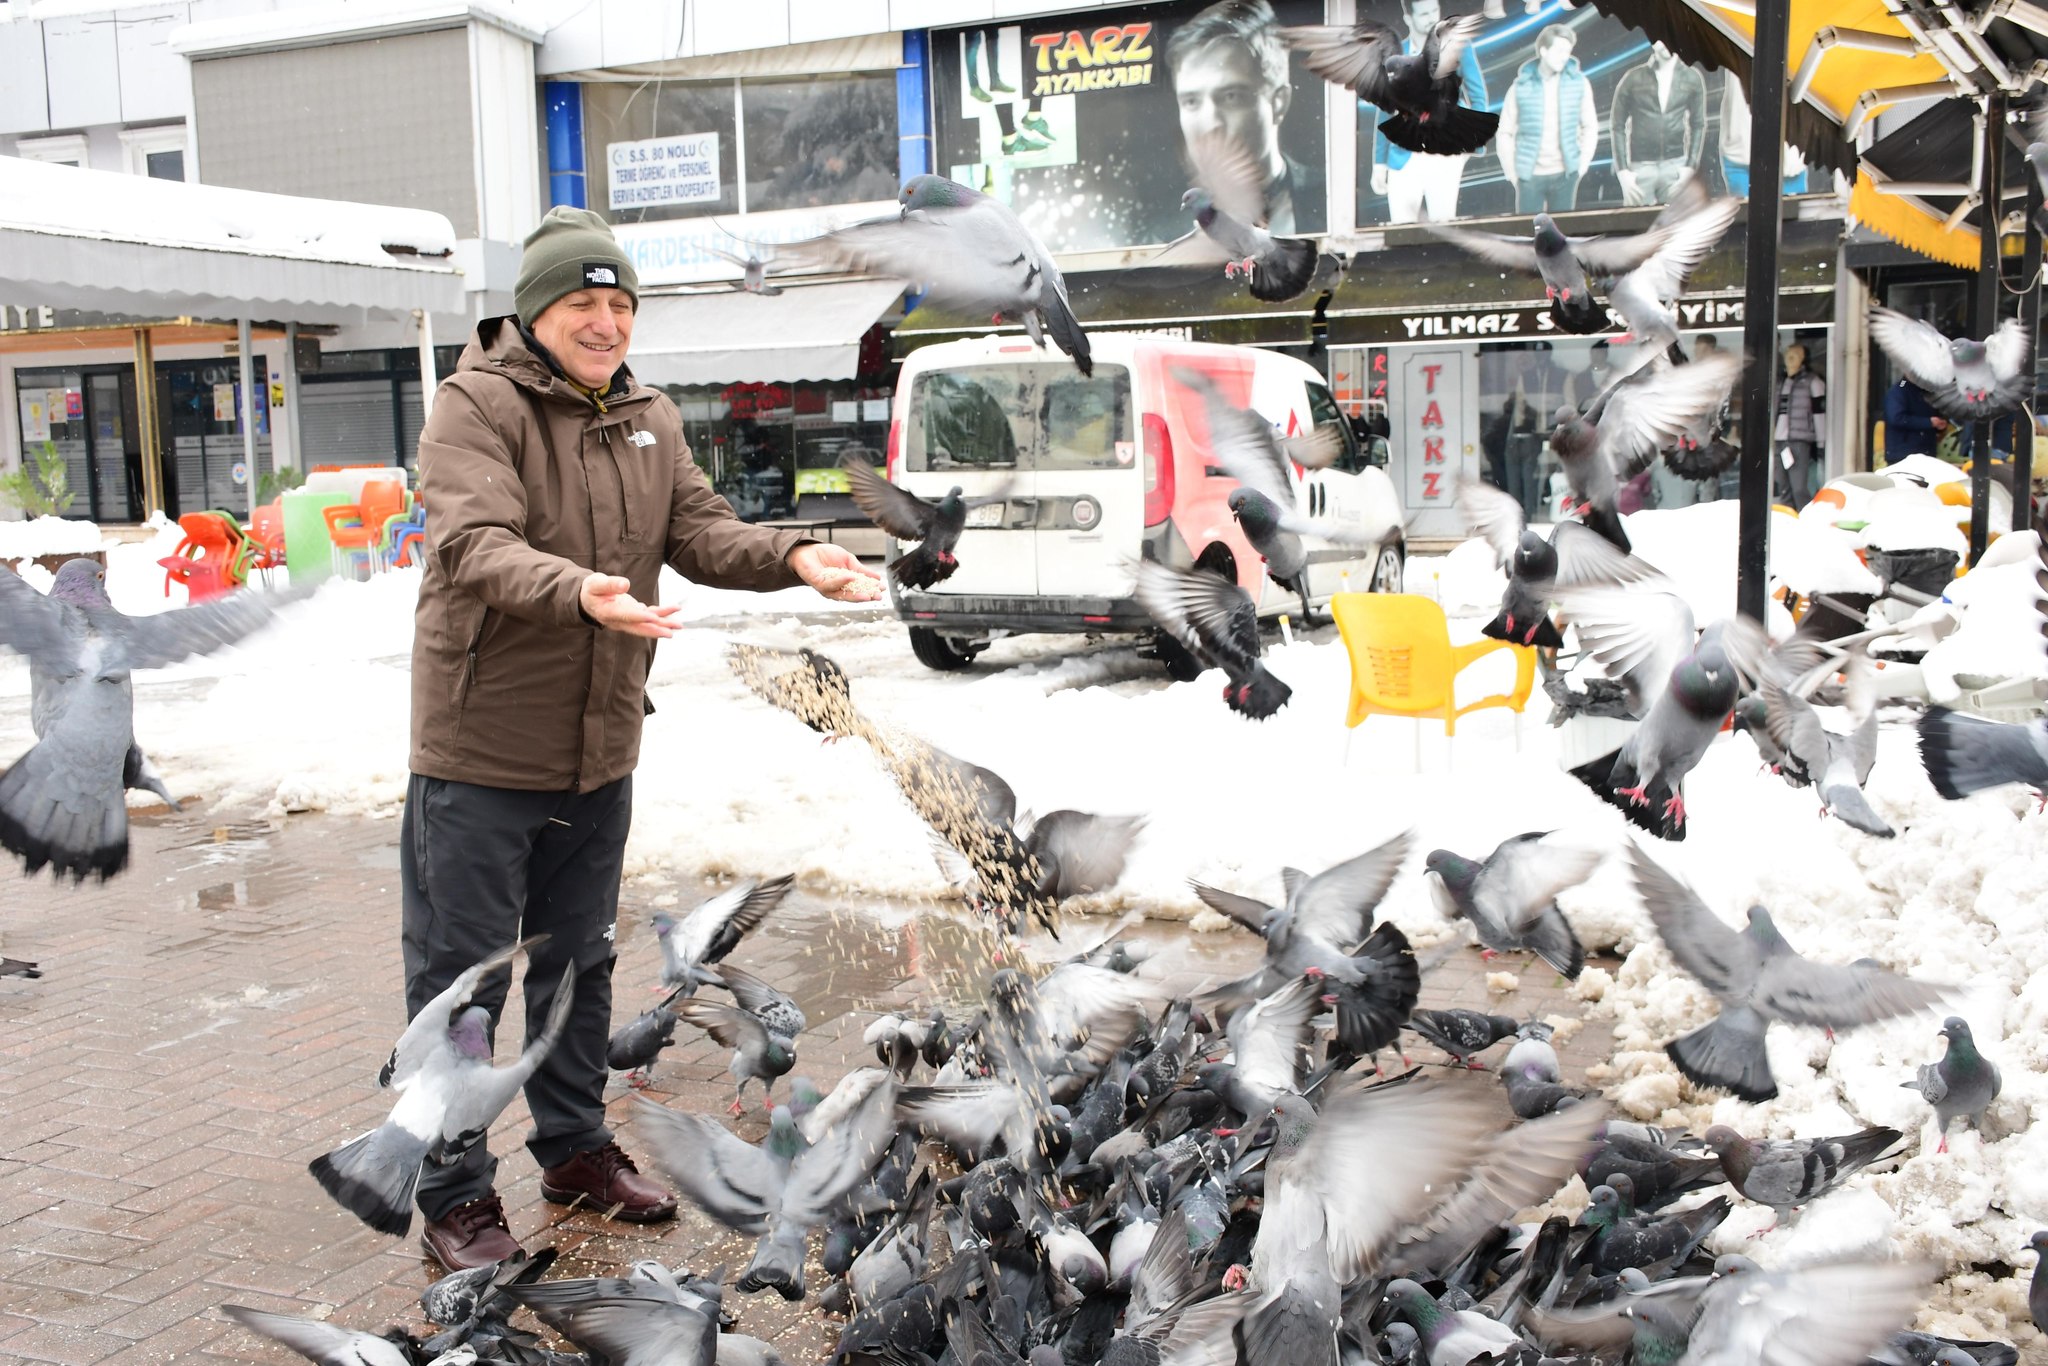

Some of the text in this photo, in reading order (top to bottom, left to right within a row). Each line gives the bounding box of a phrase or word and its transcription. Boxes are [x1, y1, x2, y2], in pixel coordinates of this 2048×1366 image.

[1030, 22, 1153, 73] TARZ
[1032, 64, 1153, 96] AYAKKABI
[667, 144, 696, 159] NOLU
[1402, 313, 1520, 338] YILMAZ
[1420, 364, 1446, 500] TARZ
